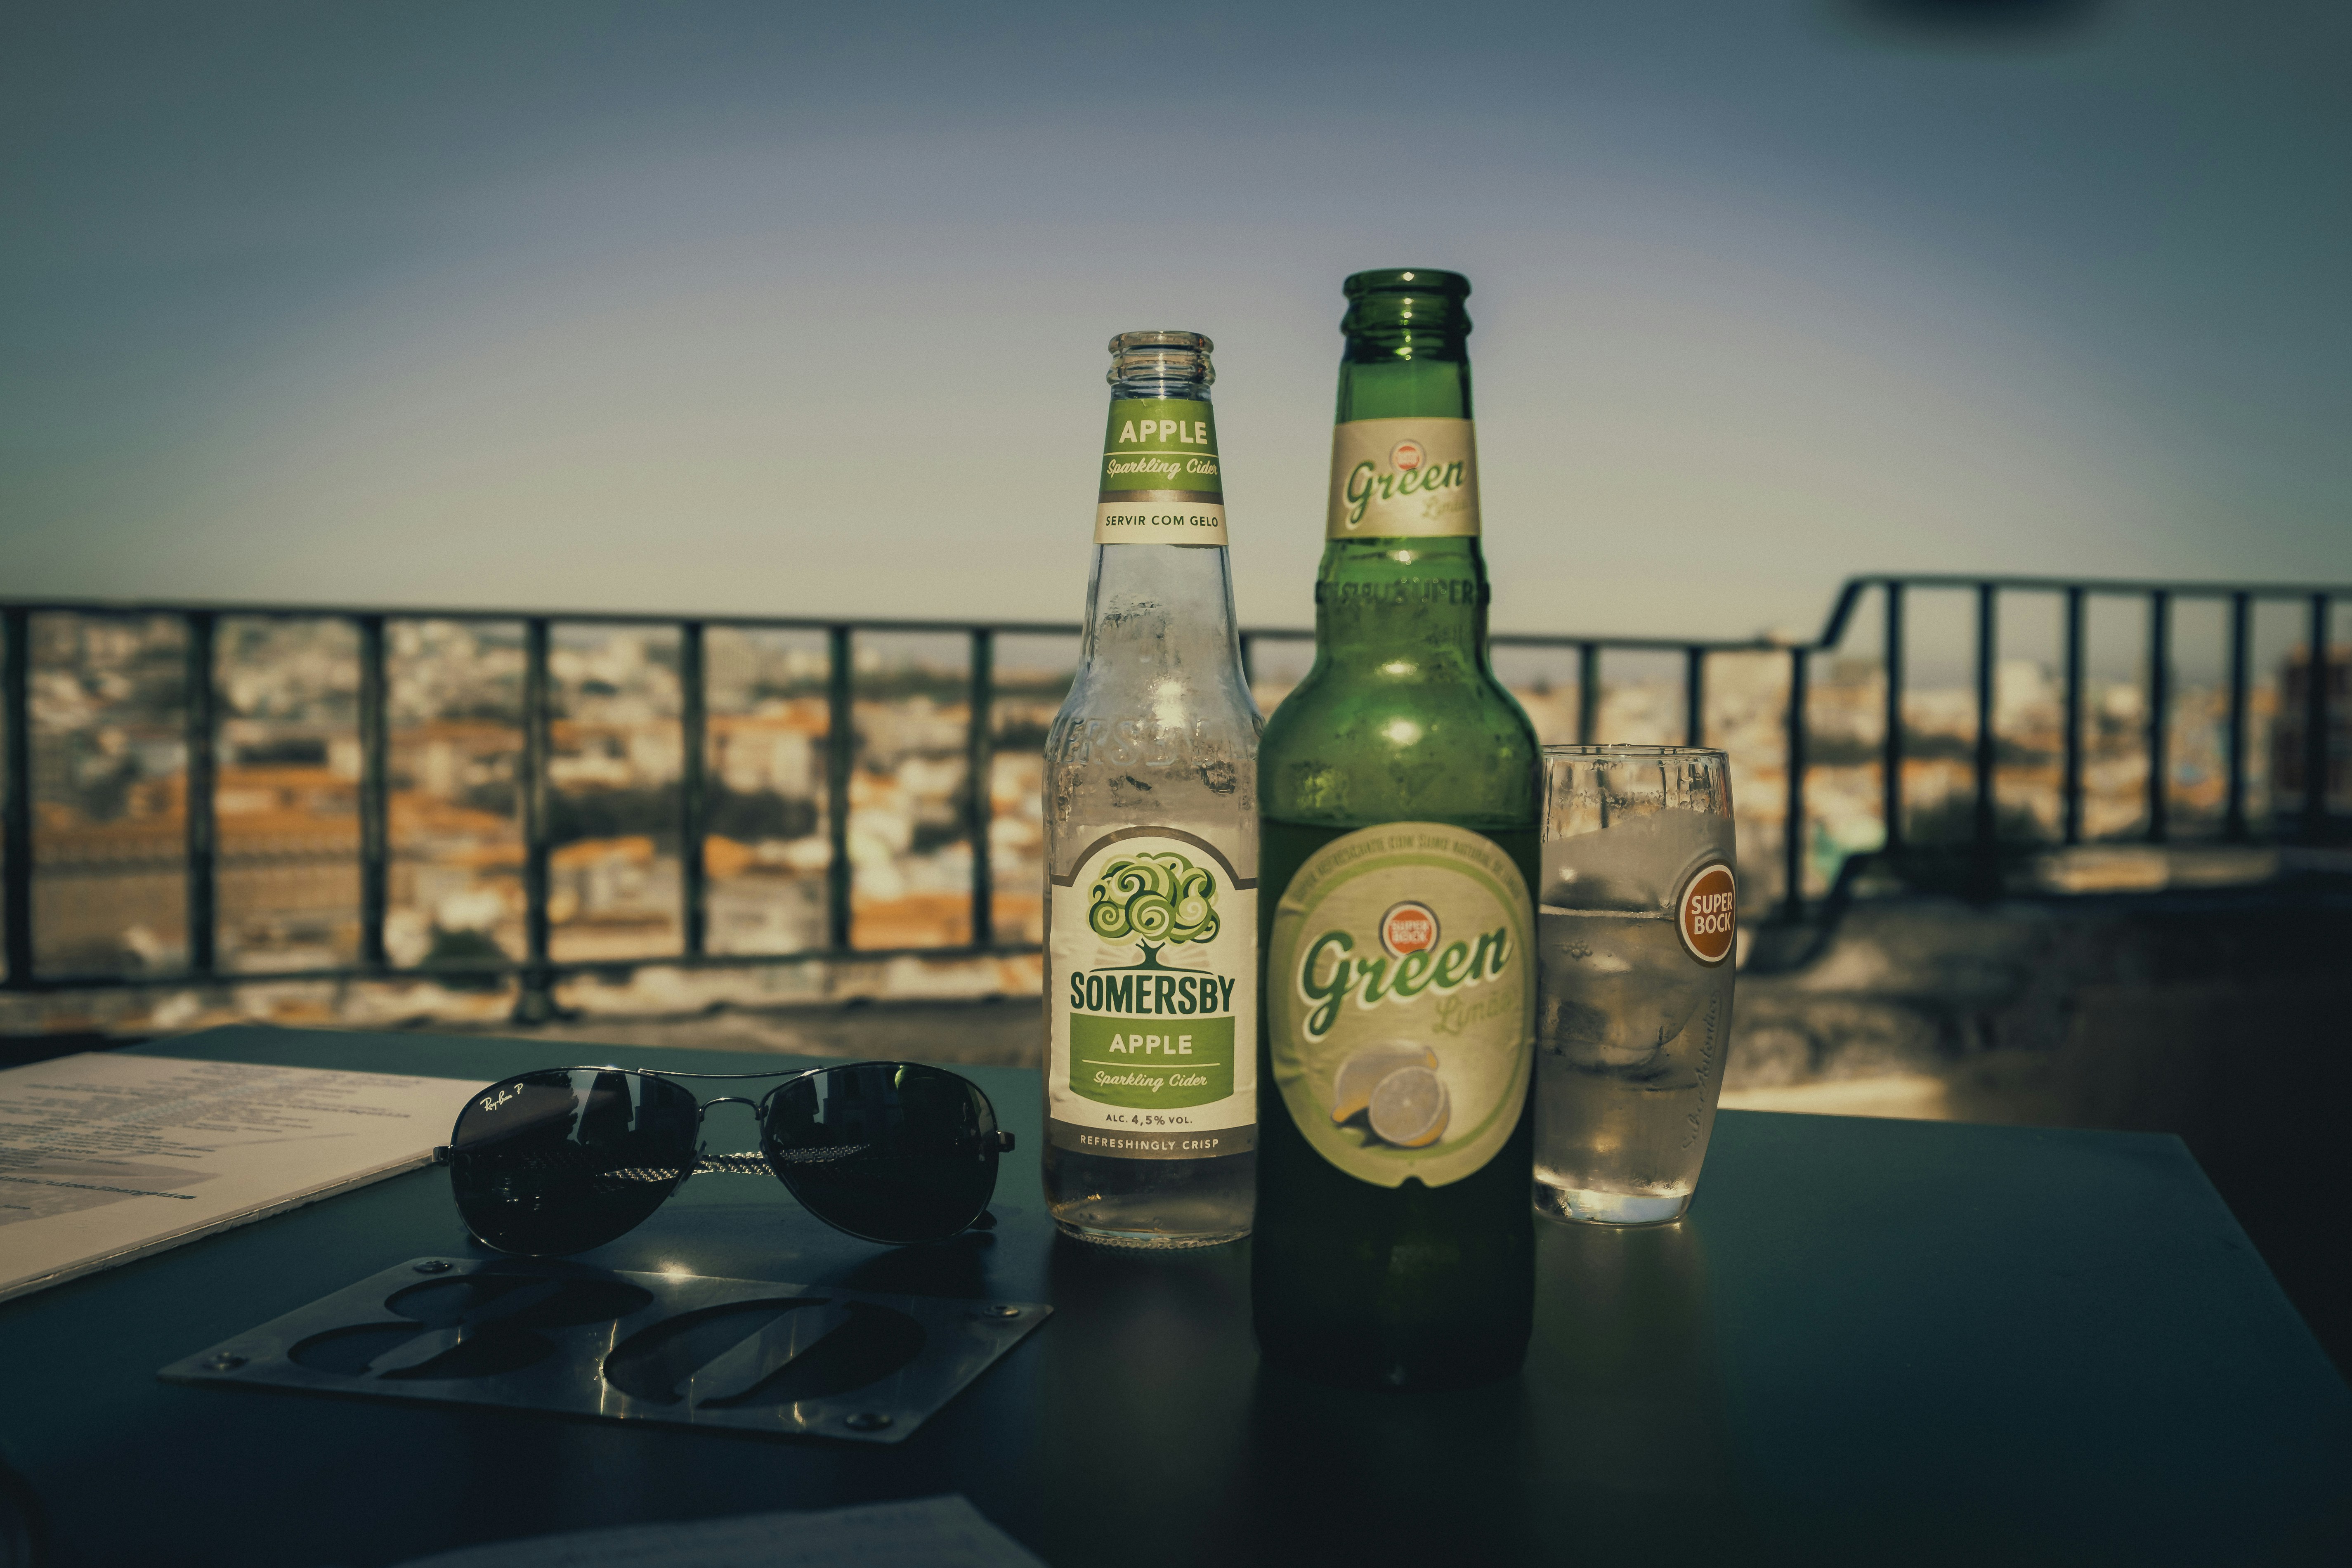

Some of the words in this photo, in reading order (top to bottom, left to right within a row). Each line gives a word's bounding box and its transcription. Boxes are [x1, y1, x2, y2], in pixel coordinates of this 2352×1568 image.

[1119, 420, 1207, 444] APPLE
[1107, 457, 1181, 480] Sparkling
[1186, 458, 1218, 475] Cider
[1346, 459, 1464, 524] Green
[1105, 515, 1145, 526] SERVIR
[1152, 515, 1184, 526] COM
[1190, 516, 1218, 527] GELO
[1692, 892, 1732, 914] SUPER
[1694, 912, 1731, 935] BOCK
[1071, 971, 1235, 1014] SOMERSBY
[1302, 927, 1507, 1036] Green
[1109, 1033, 1192, 1054] APPLE
[1093, 1070, 1164, 1092] Sparkling
[1169, 1073, 1208, 1087] Cider
[480, 1090, 512, 1111] Ray-Ban
[514, 1083, 523, 1095] P
[1106, 1114, 1128, 1123] ALC.
[1132, 1115, 1165, 1126] 4,5%
[1169, 1116, 1193, 1124] VOL.
[1080, 1134, 1176, 1150] REFRESHINGLY
[1182, 1139, 1219, 1150] CRISP
